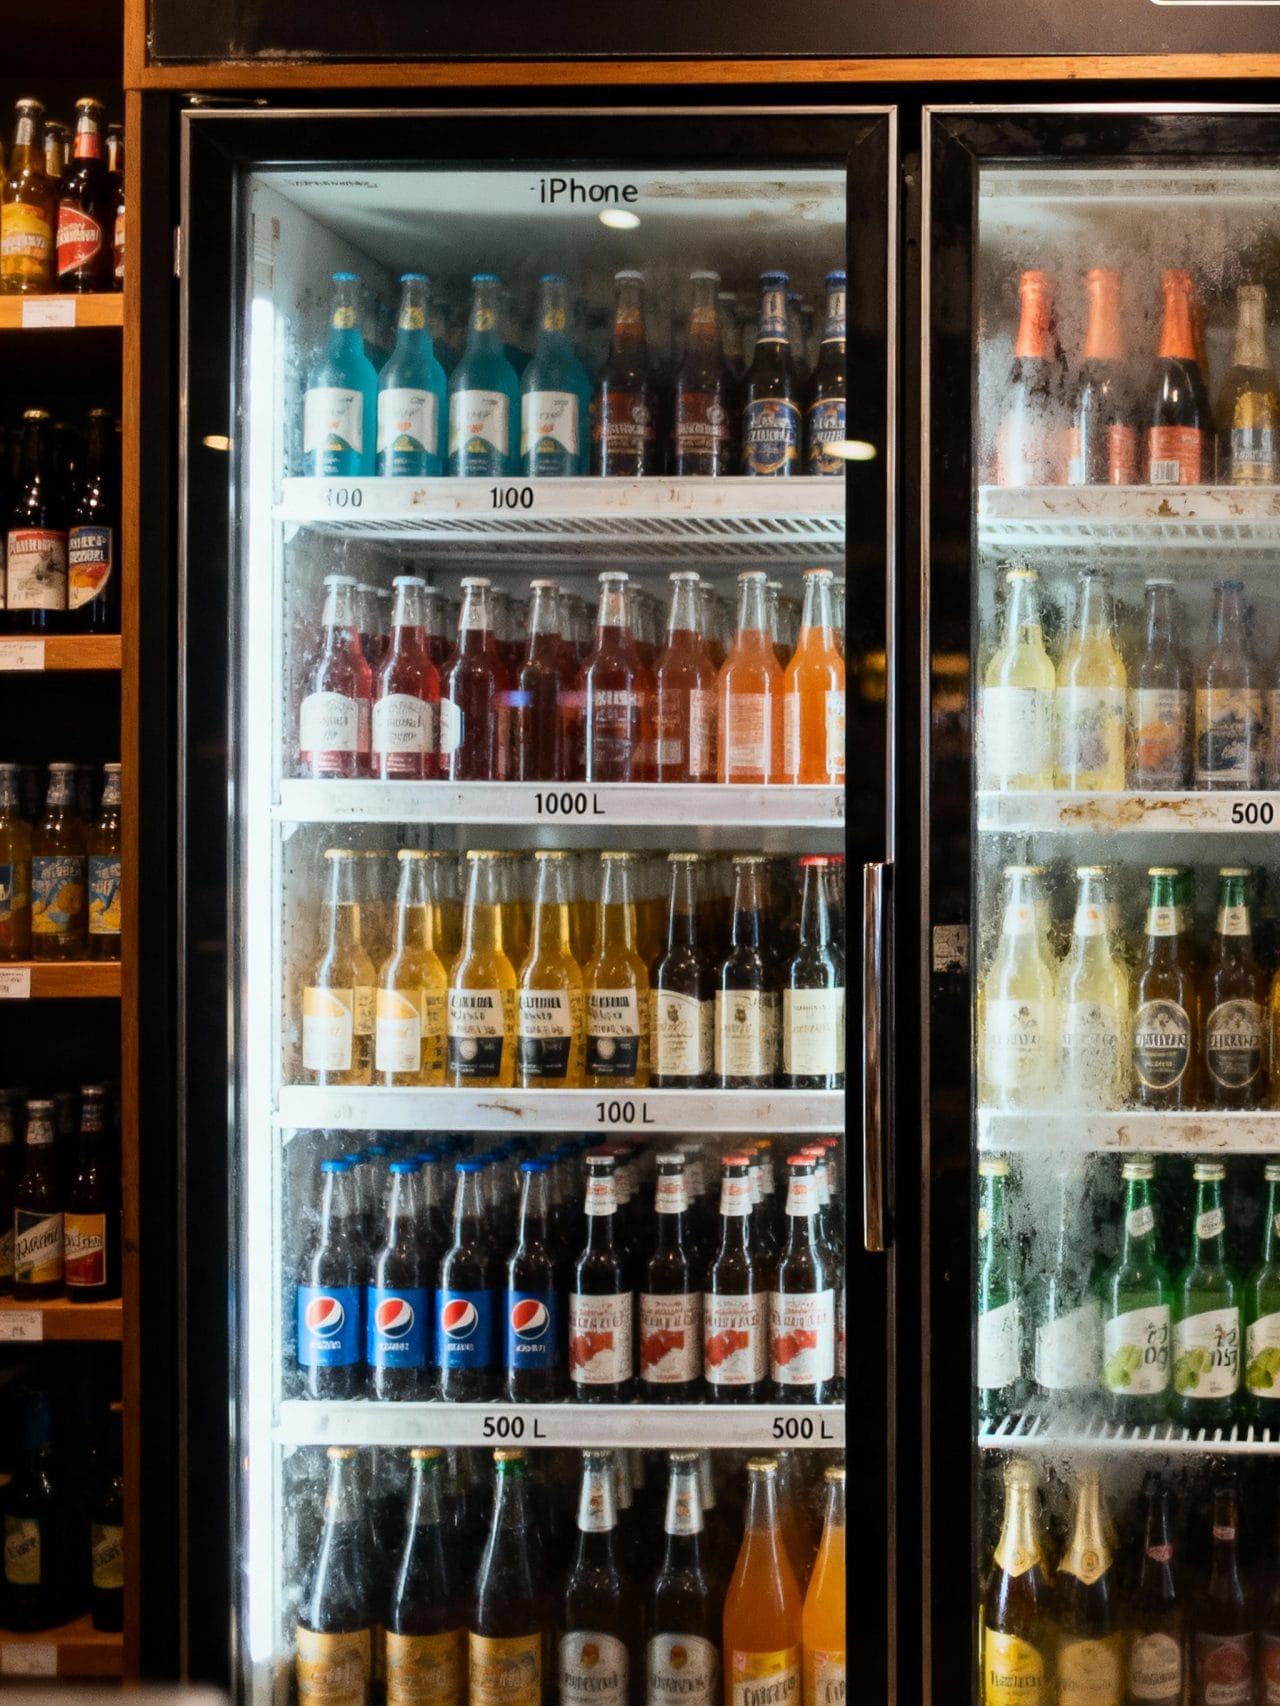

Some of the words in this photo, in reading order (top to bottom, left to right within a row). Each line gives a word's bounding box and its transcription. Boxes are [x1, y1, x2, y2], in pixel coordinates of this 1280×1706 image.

[540, 178, 638, 203] iPhone
[535, 792, 587, 814] 1000
[593, 793, 606, 814] L
[1231, 802, 1274, 824] 500
[596, 1101, 635, 1123] 100
[642, 1102, 655, 1123] L
[482, 1416, 524, 1438] 500
[534, 1418, 546, 1438] L
[772, 1417, 813, 1439] 500
[821, 1419, 834, 1439] L
